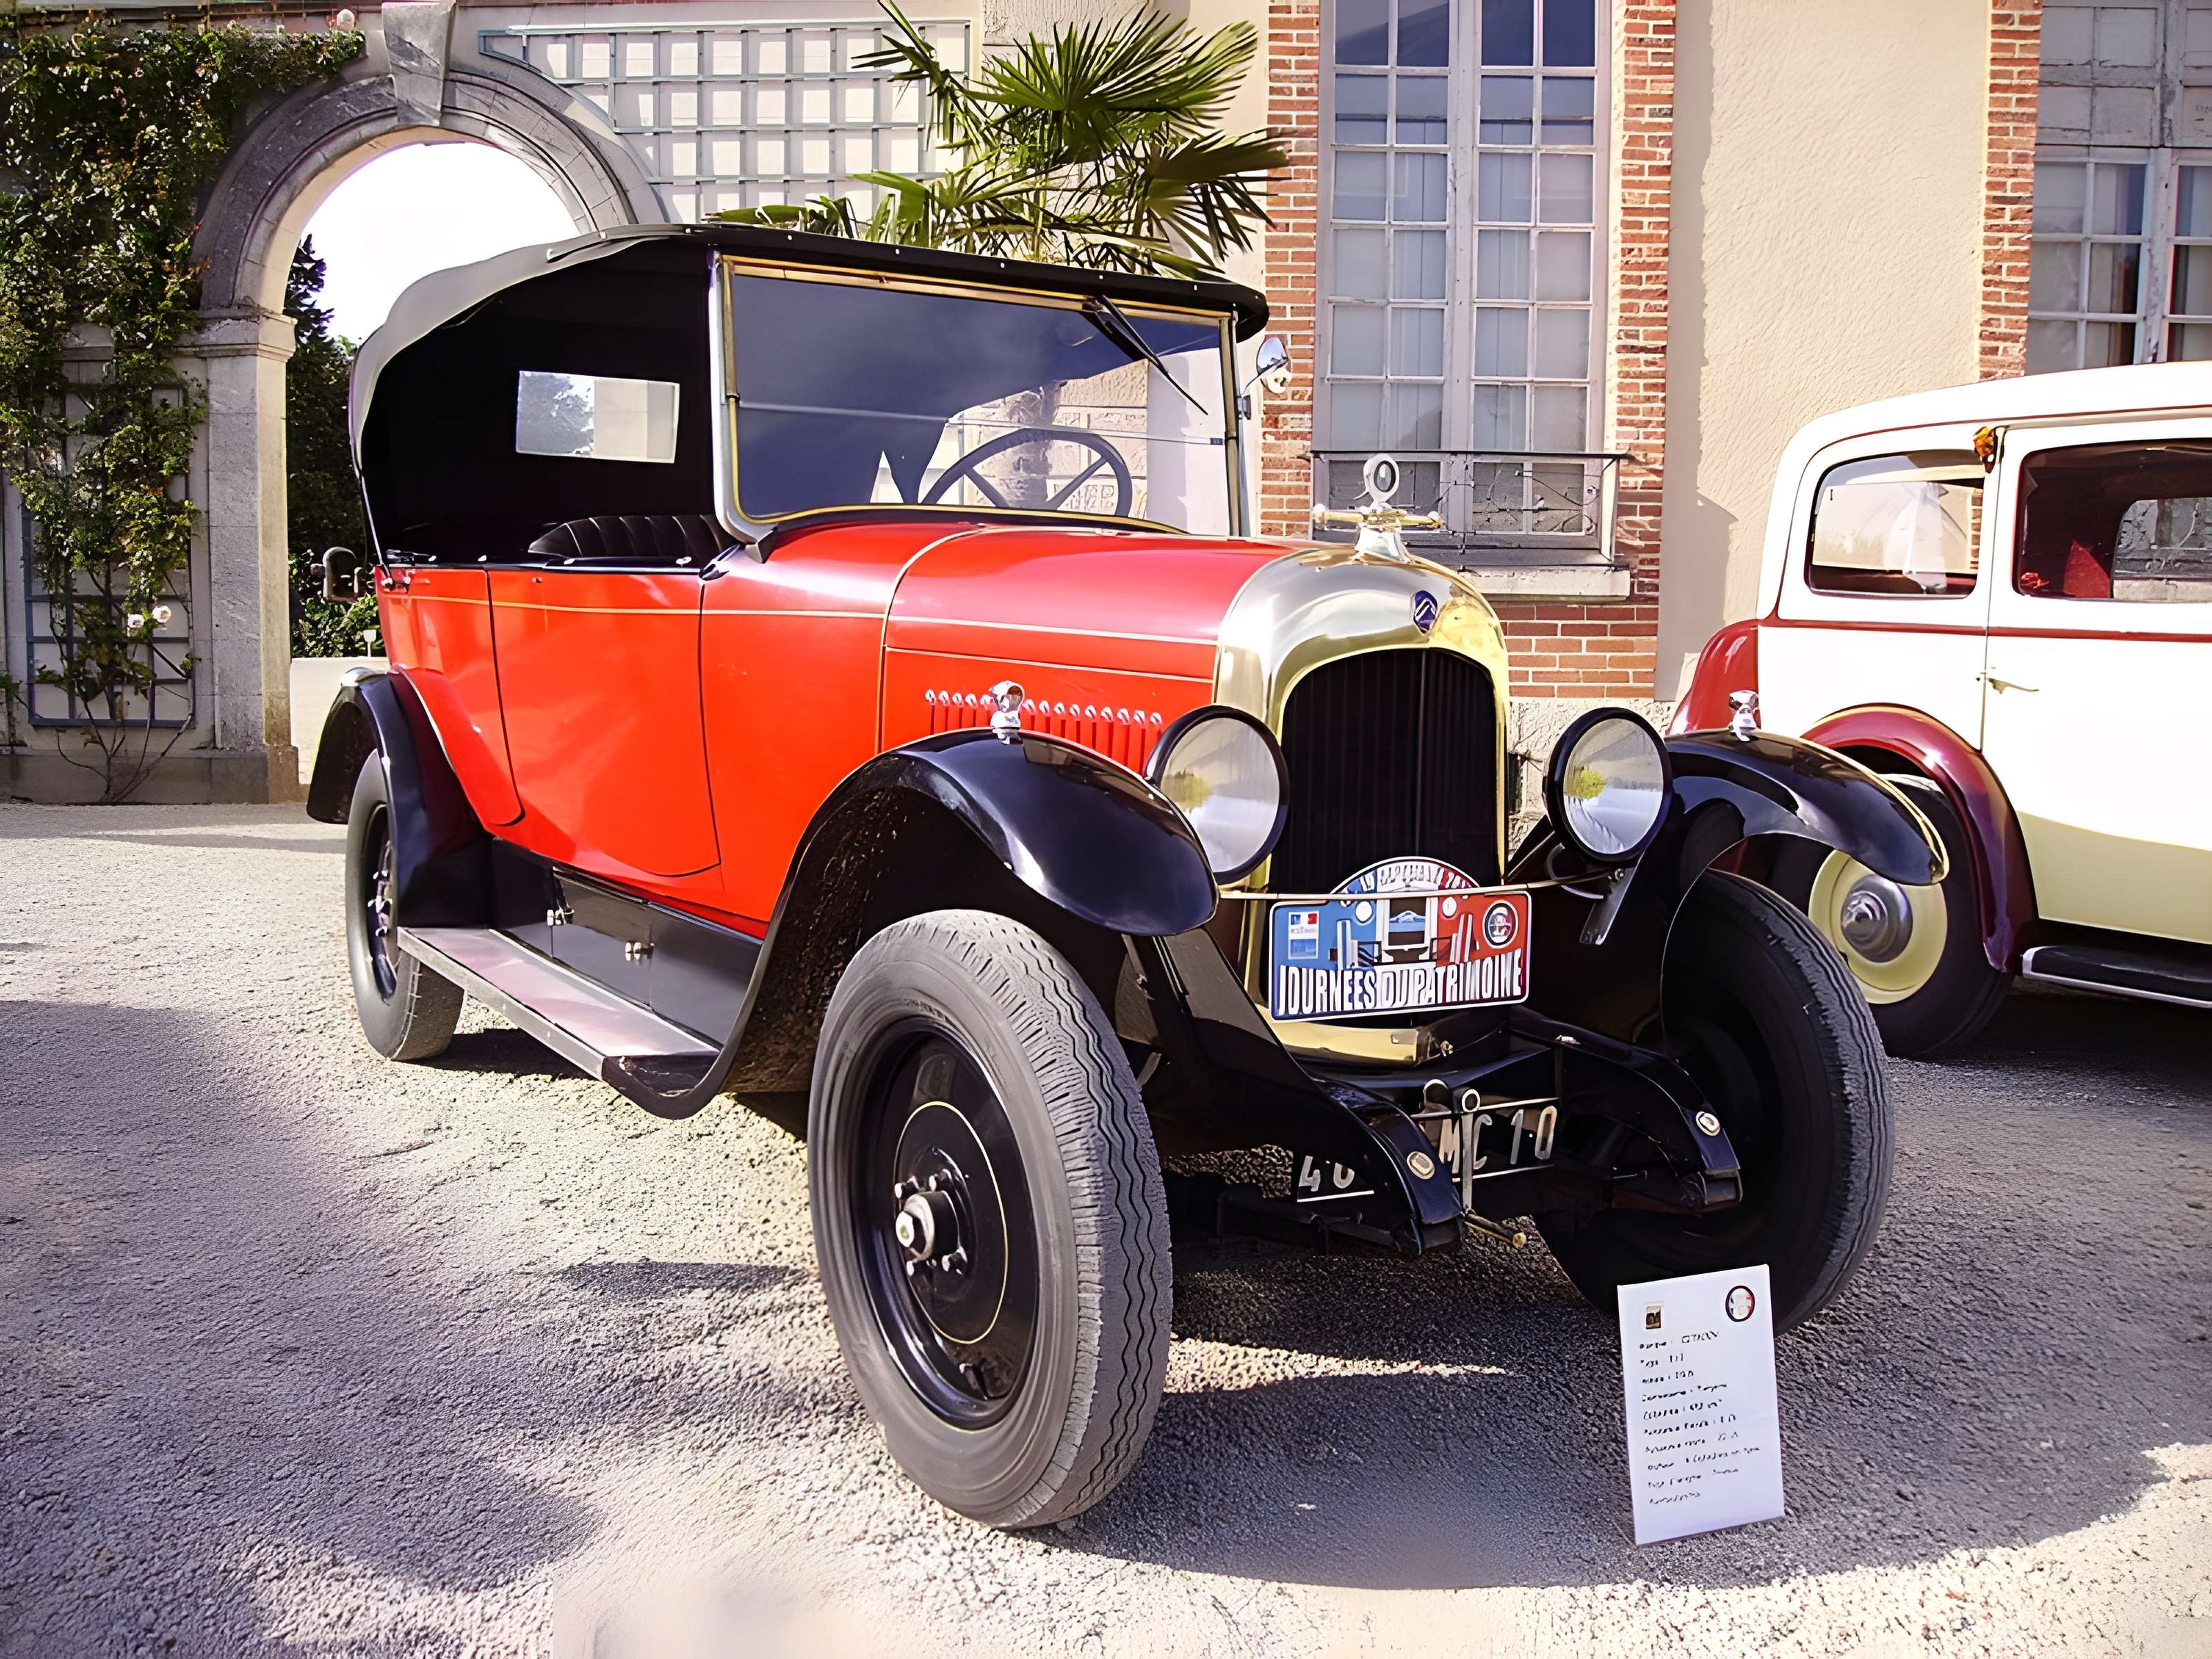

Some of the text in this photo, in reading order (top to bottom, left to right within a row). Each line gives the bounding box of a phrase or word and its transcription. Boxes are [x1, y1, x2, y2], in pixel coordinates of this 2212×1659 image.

[1382, 969, 1409, 1007] DU
[1414, 948, 1521, 1005] PATRIMOINE
[1510, 1105, 1557, 1165] 10
